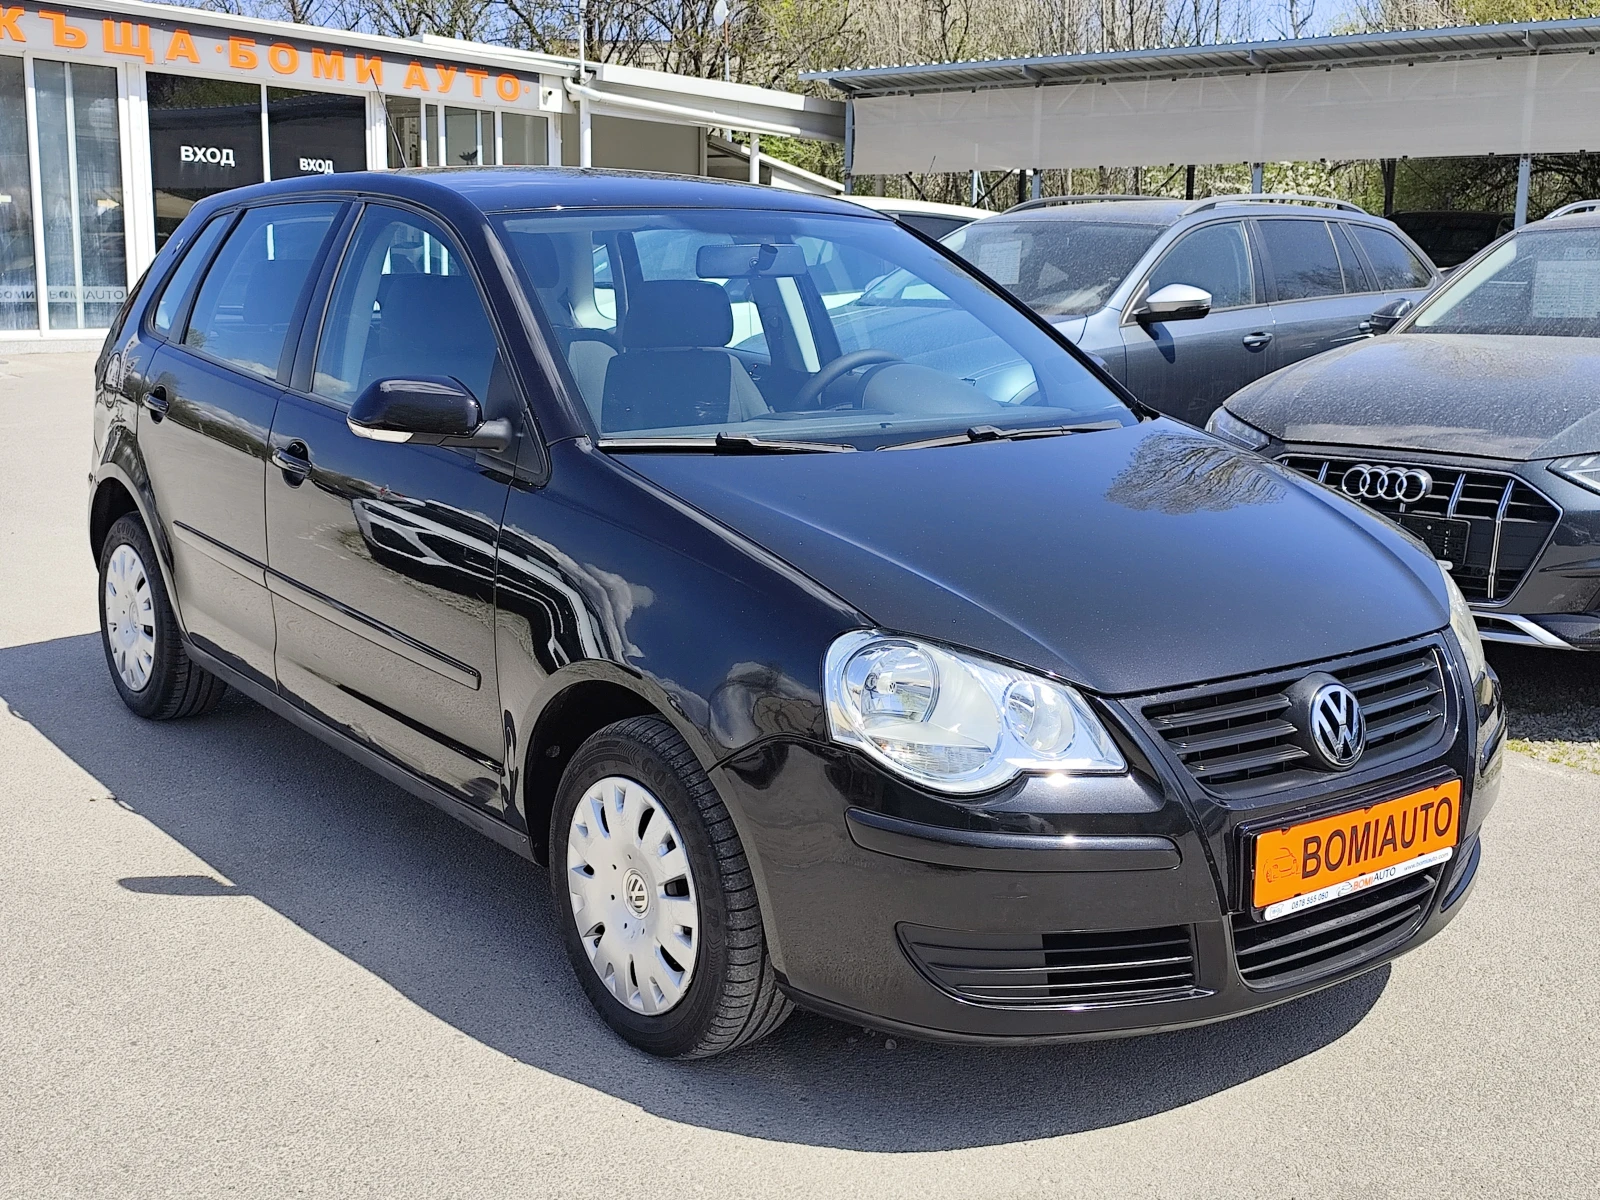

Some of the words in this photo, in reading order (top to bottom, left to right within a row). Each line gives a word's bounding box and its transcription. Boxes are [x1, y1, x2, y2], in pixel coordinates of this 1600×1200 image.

[0, 4, 200, 64] КЪЩА
[229, 35, 384, 85] БОМИ
[403, 60, 521, 102] АУТО
[180, 145, 236, 167] ВХОД
[299, 158, 334, 174] ВХОД
[1309, 684, 1363, 766] VW
[1301, 796, 1453, 880] BOMIAUTO
